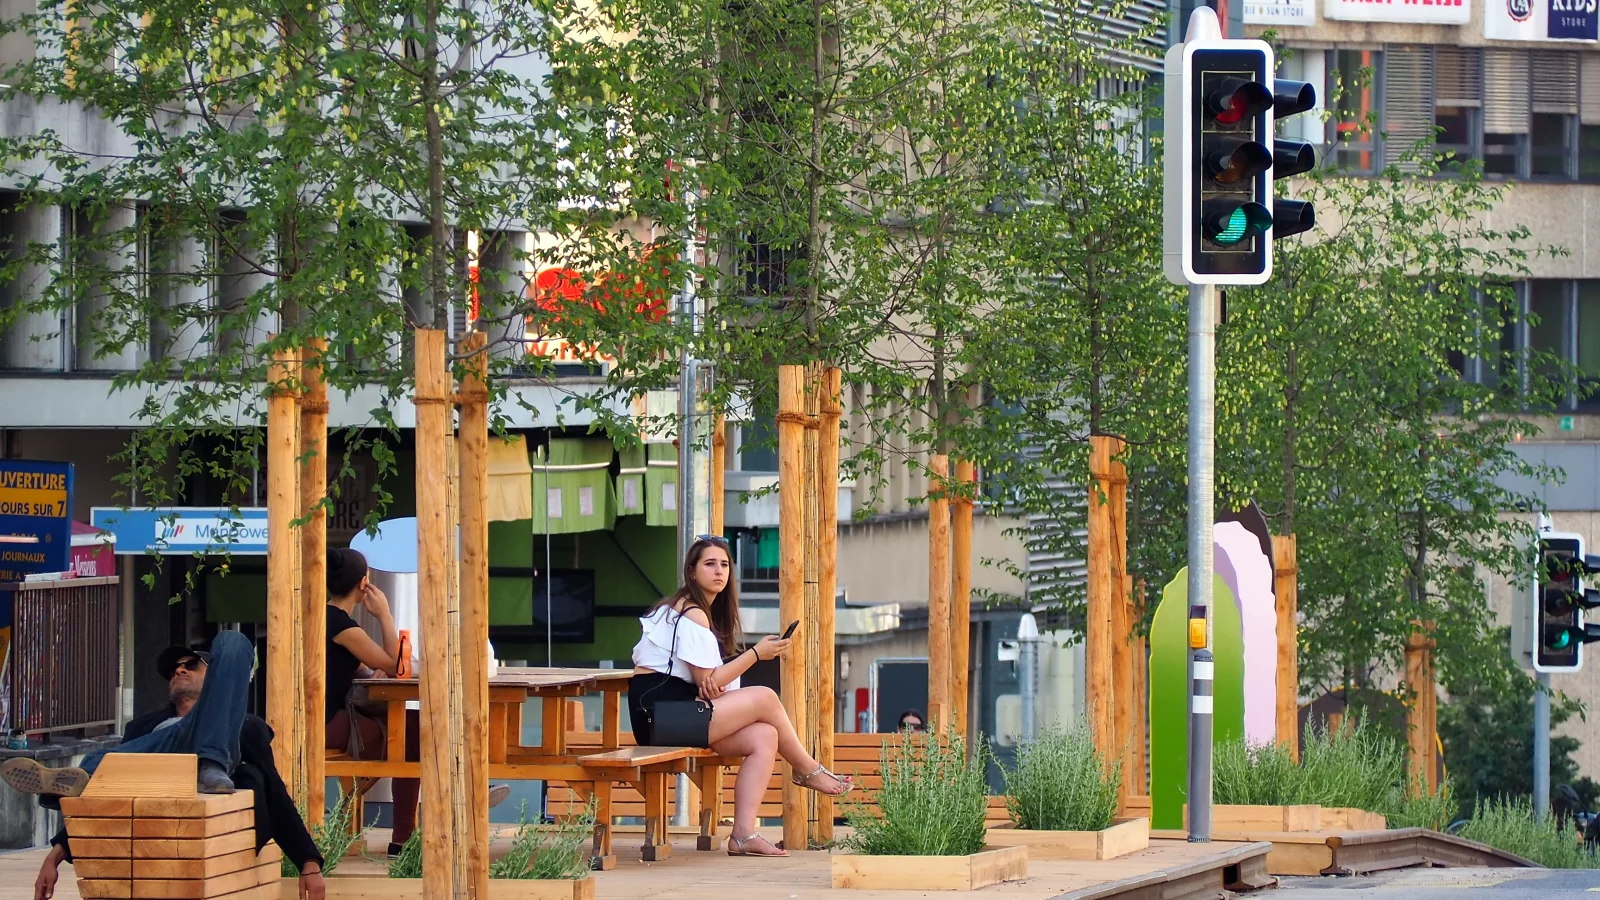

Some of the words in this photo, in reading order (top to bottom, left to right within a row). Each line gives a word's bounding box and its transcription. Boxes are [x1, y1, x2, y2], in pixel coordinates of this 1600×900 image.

[1266, 6, 1280, 16] SUN
[1282, 7, 1304, 17] STORE
[1552, 0, 1597, 13] KIDS
[1561, 16, 1587, 27] STORE
[33, 503, 53, 516] SUR
[57, 500, 65, 517] 7
[1, 551, 46, 563] JOURNAUX
